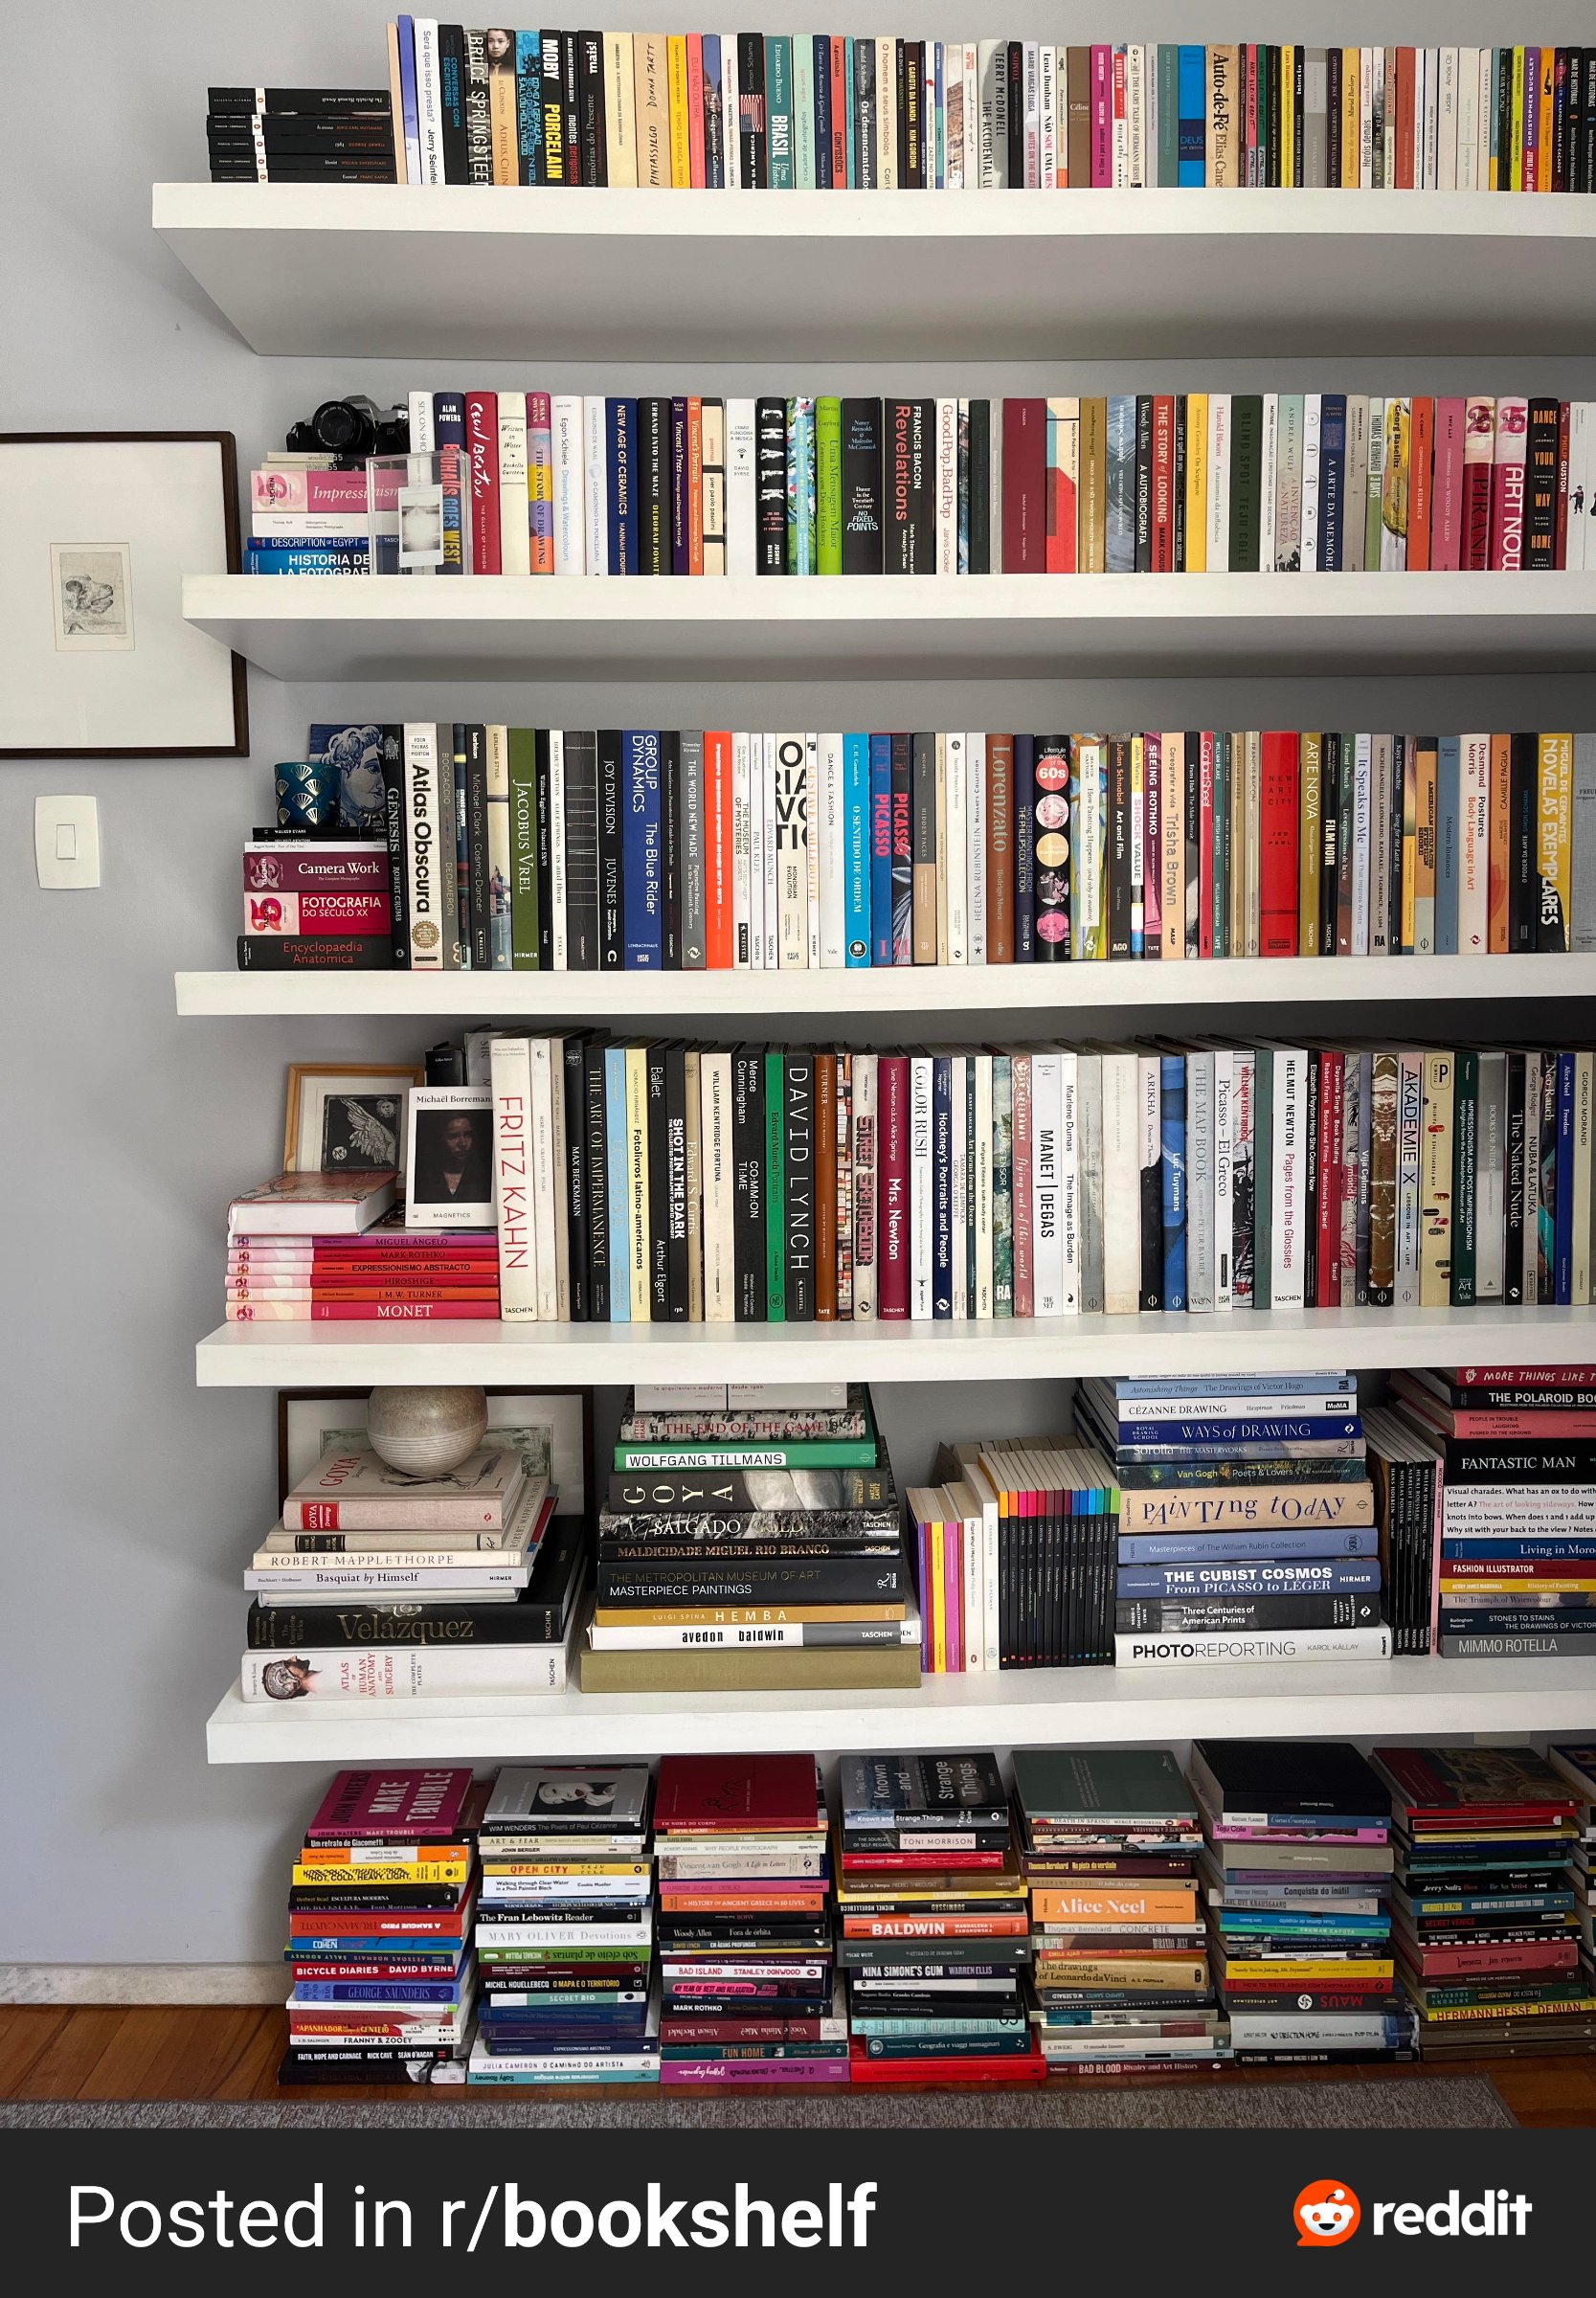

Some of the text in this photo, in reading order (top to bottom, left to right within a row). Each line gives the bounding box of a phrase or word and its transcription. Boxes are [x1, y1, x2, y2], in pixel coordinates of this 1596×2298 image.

[423, 31, 433, 50] Será
[423, 52, 432, 67] que
[468, 36, 485, 85] BRUCE
[646, 42, 658, 107] DONNA TARTT
[996, 53, 1005, 136] TERRY McDONELL
[1044, 53, 1052, 110] Lena Dunham
[424, 90, 435, 123] presta?
[543, 39, 563, 179] MOBY PORCELAIN
[708, 93, 719, 113] Peggy
[1214, 53, 1230, 159] Auto-de-Fé Elias
[708, 114, 719, 154] Guggenheim
[772, 115, 789, 158] BRASIL
[649, 125, 661, 186] PINTASSILGO
[909, 142, 917, 169] GORDON
[1158, 404, 1168, 426] THE
[560, 417, 570, 465] Egon Schiele
[759, 408, 784, 502] CHALK
[1158, 429, 1168, 463] STORY
[617, 405, 628, 515] NEW AGE OF CERAMICS
[895, 405, 911, 521] Revelations
[913, 453, 922, 488] BACON
[1137, 473, 1149, 545] AUTOBIOGRAFIA
[1157, 475, 1168, 523] LOOKING
[272, 538, 359, 548] DESCRIPTION EGYPT
[288, 554, 350, 566] HISTORIA
[632, 735, 645, 813] DYNAMICS
[644, 735, 657, 789] GROUP
[603, 760, 616, 835] JOY DIVISION
[1306, 741, 1318, 820] ARTE NOVA
[992, 746, 1011, 852] Lorenzato
[412, 764, 433, 913] Atlas Obscura
[513, 779, 534, 895] JACOBUS VREL
[875, 794, 889, 856] PICASSO
[894, 793, 909, 856] PICASSO
[1540, 739, 1560, 926] NOVELAS EXEMPLARES
[298, 862, 380, 874] Camera Work
[645, 822, 659, 915] The Blue Rider
[1166, 814, 1180, 906] Trisha Brown
[605, 858, 617, 905] JUVENES
[302, 896, 382, 909] FOTOGRAFIA
[283, 942, 363, 956] Encyclopaedia
[293, 954, 354, 963] Anatomica
[651, 1067, 663, 1098] Ballet
[736, 1060, 748, 1124] Cunningham
[749, 1060, 758, 1093] Merce
[915, 1066, 928, 1158] COLOR RUSH
[1285, 1059, 1295, 1146] HELMUT NEWTON
[499, 1096, 529, 1270] FRITZ KAHN
[673, 1118, 686, 1239] SHOT IN THE DARK
[789, 1067, 809, 1270] DAVID LYNCH
[1040, 1130, 1055, 1238] MANET DEGAS
[1510, 1111, 1522, 1228] The Naked Nude
[634, 1128, 644, 1270] Fotolivros latino-americanos
[888, 1178, 902, 1260] Mrs. Newton
[423, 1263, 471, 1272] ABSTRACTO
[377, 1304, 433, 1318] MONET
[1181, 1423, 1311, 1438] WAYS of DRAWING
[630, 1454, 783, 1467] WOLFGANG TILLMANS
[1461, 1456, 1576, 1470] FANTASTIC MAN
[654, 1521, 741, 1536] SALGADO
[271, 1553, 454, 1567] ROBERT MAPPLETHORPE
[1164, 1567, 1333, 1583] THE CUBIST COSMOS
[316, 1572, 419, 1584] Basquiat by Himself
[609, 1584, 753, 1596] MASTERPIECE PAINTINGS
[1165, 1577, 1331, 1593] From PICASSO to LÉGER
[1339, 1574, 1371, 1584] HIRMER
[336, 1614, 474, 1644] Velázquez
[682, 1628, 784, 1643] avedon baldwin
[1457, 1637, 1559, 1653] MIMMO ROTELLA
[1133, 1641, 1296, 1659] PHOTOREPORTING
[1056, 1899, 1145, 1915] Alice Neel
[871, 1923, 946, 1936] BALDWIN
[297, 1966, 379, 1976] BICYCLE DIARIES
[389, 1965, 419, 1973] DAVID
[678, 1967, 723, 1975] BAD ISLAND
[862, 1966, 944, 1976] NINA SIMONE'S GUM
[1319, 1994, 1363, 2008] MAUS
[1436, 2001, 1582, 2021] HERMANN HESSE DEMIAN
[722, 2047, 766, 2059] FUN HOME
